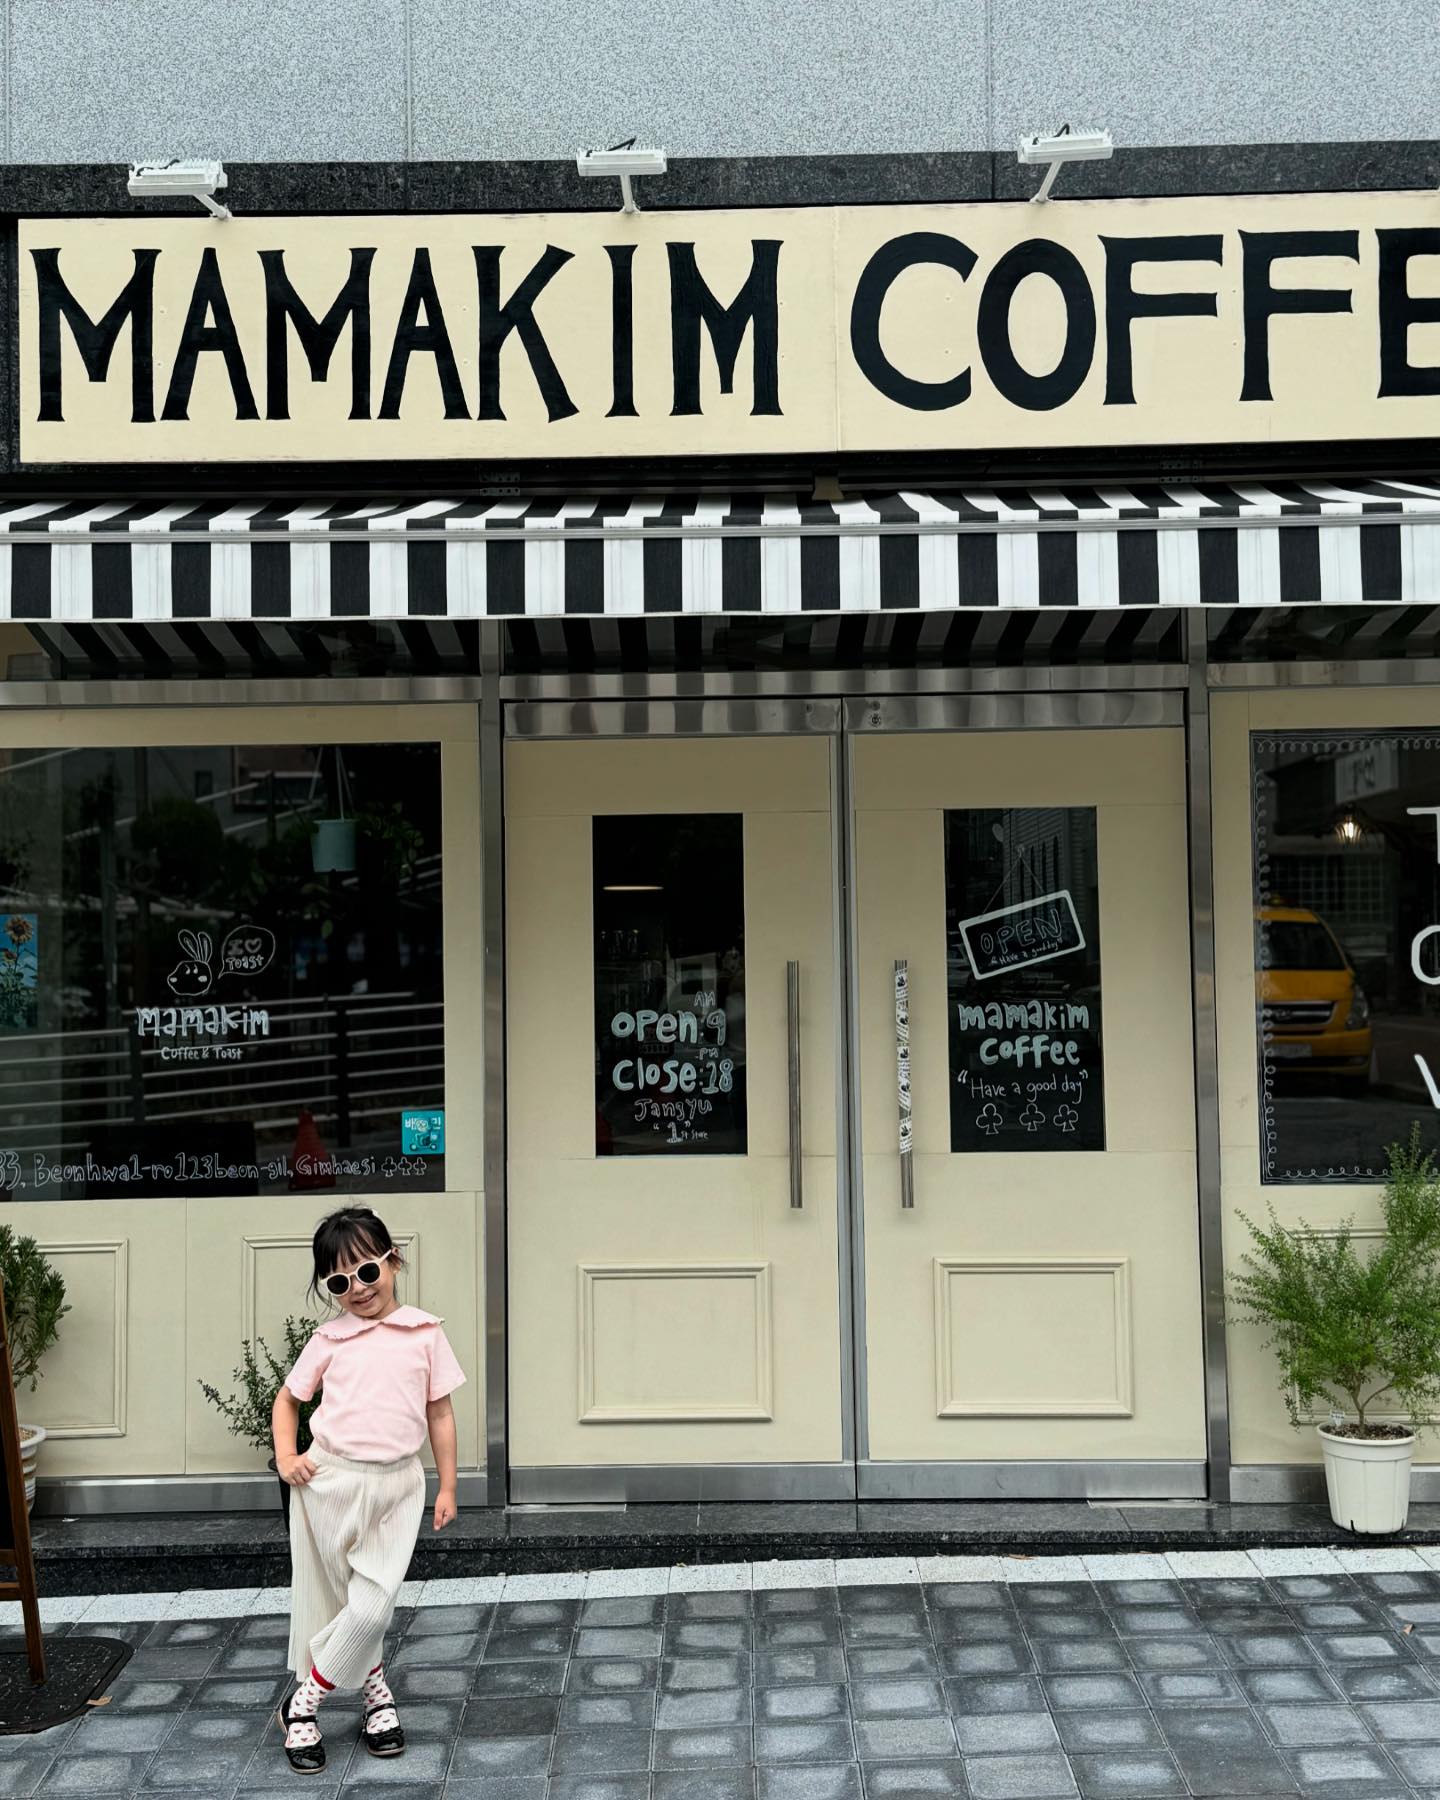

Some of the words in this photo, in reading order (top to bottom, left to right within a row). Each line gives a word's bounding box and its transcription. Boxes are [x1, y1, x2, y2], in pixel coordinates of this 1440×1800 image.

[29, 239, 784, 423] MAMAKIM
[980, 908, 1061, 955] OPEN
[227, 939, 244, 956] I
[226, 954, 264, 970] Toast
[202, 1047, 209, 1060] &
[213, 1047, 243, 1060] Toast
[1012, 1082, 1021, 1095] a
[1027, 1074, 1057, 1103] good
